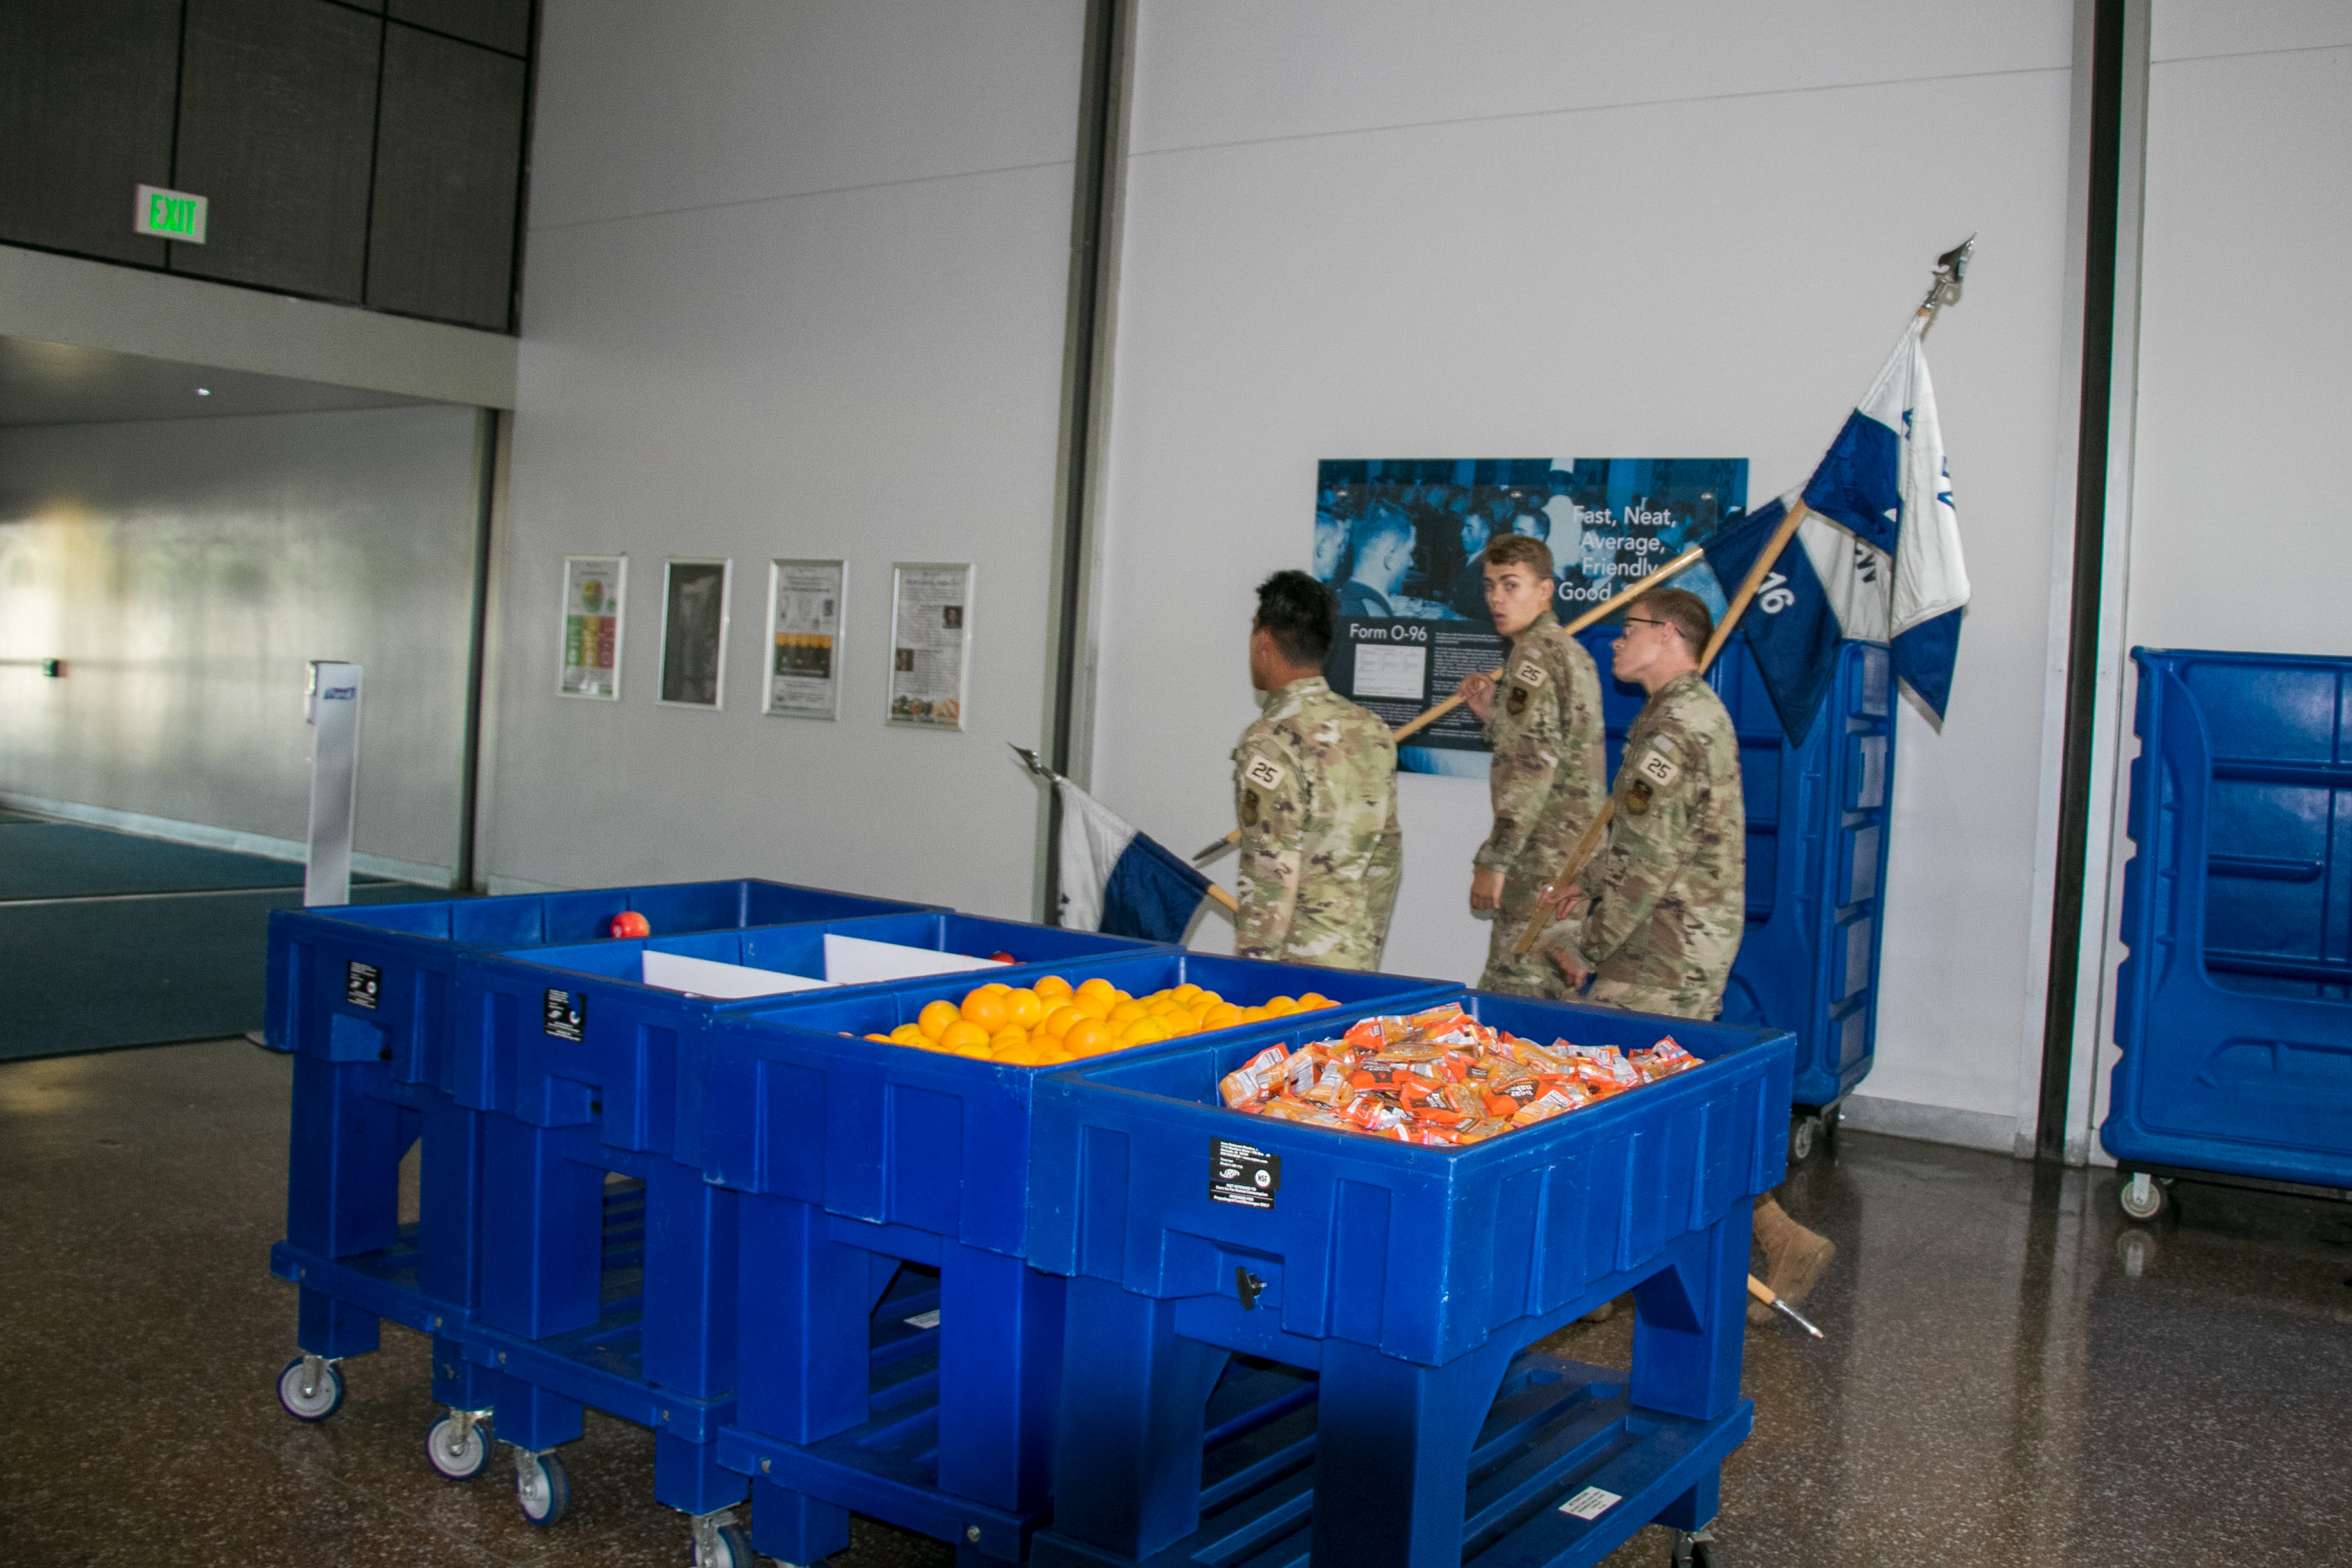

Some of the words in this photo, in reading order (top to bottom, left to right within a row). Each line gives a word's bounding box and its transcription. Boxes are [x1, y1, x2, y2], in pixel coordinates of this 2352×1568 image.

[150, 194, 197, 235] EXIT
[1574, 505, 1617, 527] Fast,
[1624, 506, 1677, 528] Neat,
[1580, 530, 1665, 556] Average,
[1558, 582, 1611, 601] Good
[1757, 571, 1795, 614] 16
[1349, 623, 1387, 639] Form
[1391, 625, 1427, 641] O-96
[1521, 665, 1542, 681] 25
[1252, 762, 1278, 783] 25
[1647, 758, 1672, 778] 25
